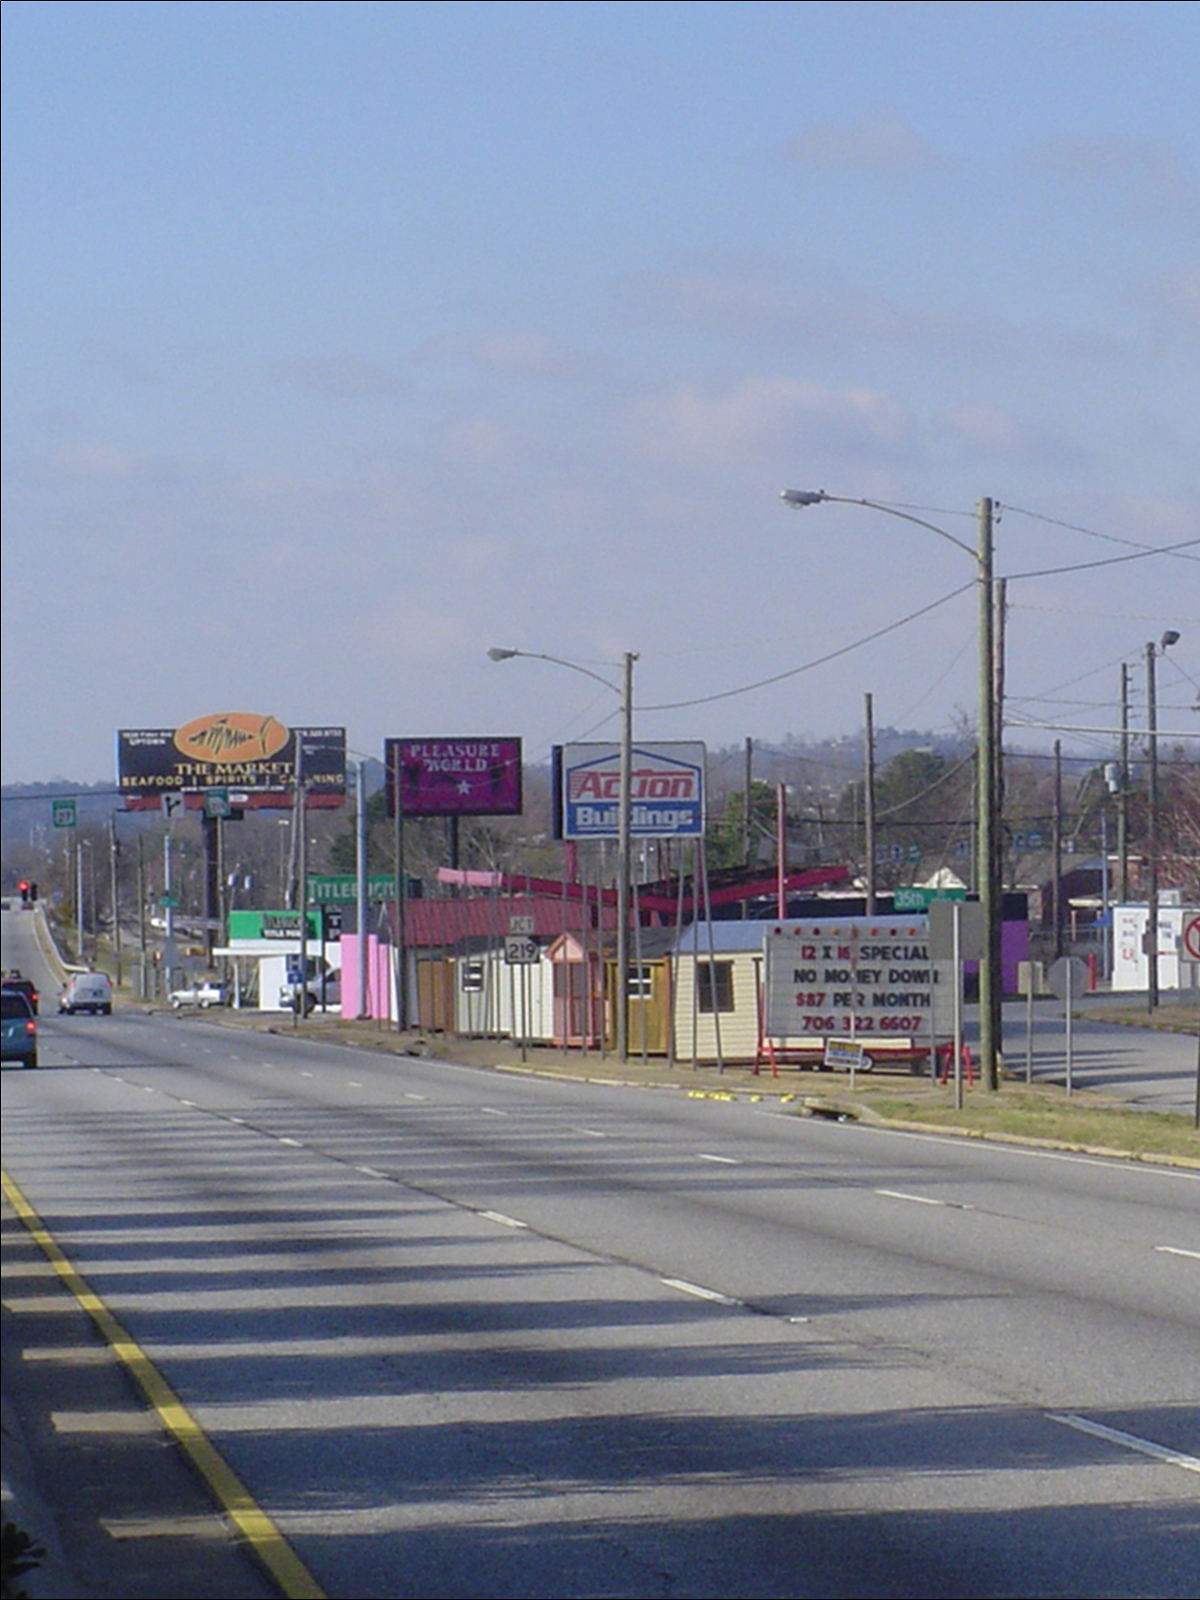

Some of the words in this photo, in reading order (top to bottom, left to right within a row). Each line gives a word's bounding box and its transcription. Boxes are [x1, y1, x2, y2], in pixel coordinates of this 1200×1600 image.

[410, 743, 500, 757] PLEASURE
[174, 763, 210, 775] THE
[215, 762, 293, 775] MARKET
[423, 759, 488, 772] WORLD
[122, 776, 183, 787] SEAFOOD
[206, 775, 256, 785] SPIRITS
[569, 768, 694, 799] Acion
[576, 806, 694, 826] Buidings
[508, 943, 536, 959] 219
[801, 945, 816, 960] 12
[860, 945, 929, 960] SPECIAL
[793, 968, 817, 983] NO
[832, 992, 865, 1007] PER
[872, 992, 931, 1007] MONTH
[802, 1016, 834, 1030] 706
[842, 1016, 874, 1030] 322
[879, 1016, 922, 1030] 6607
